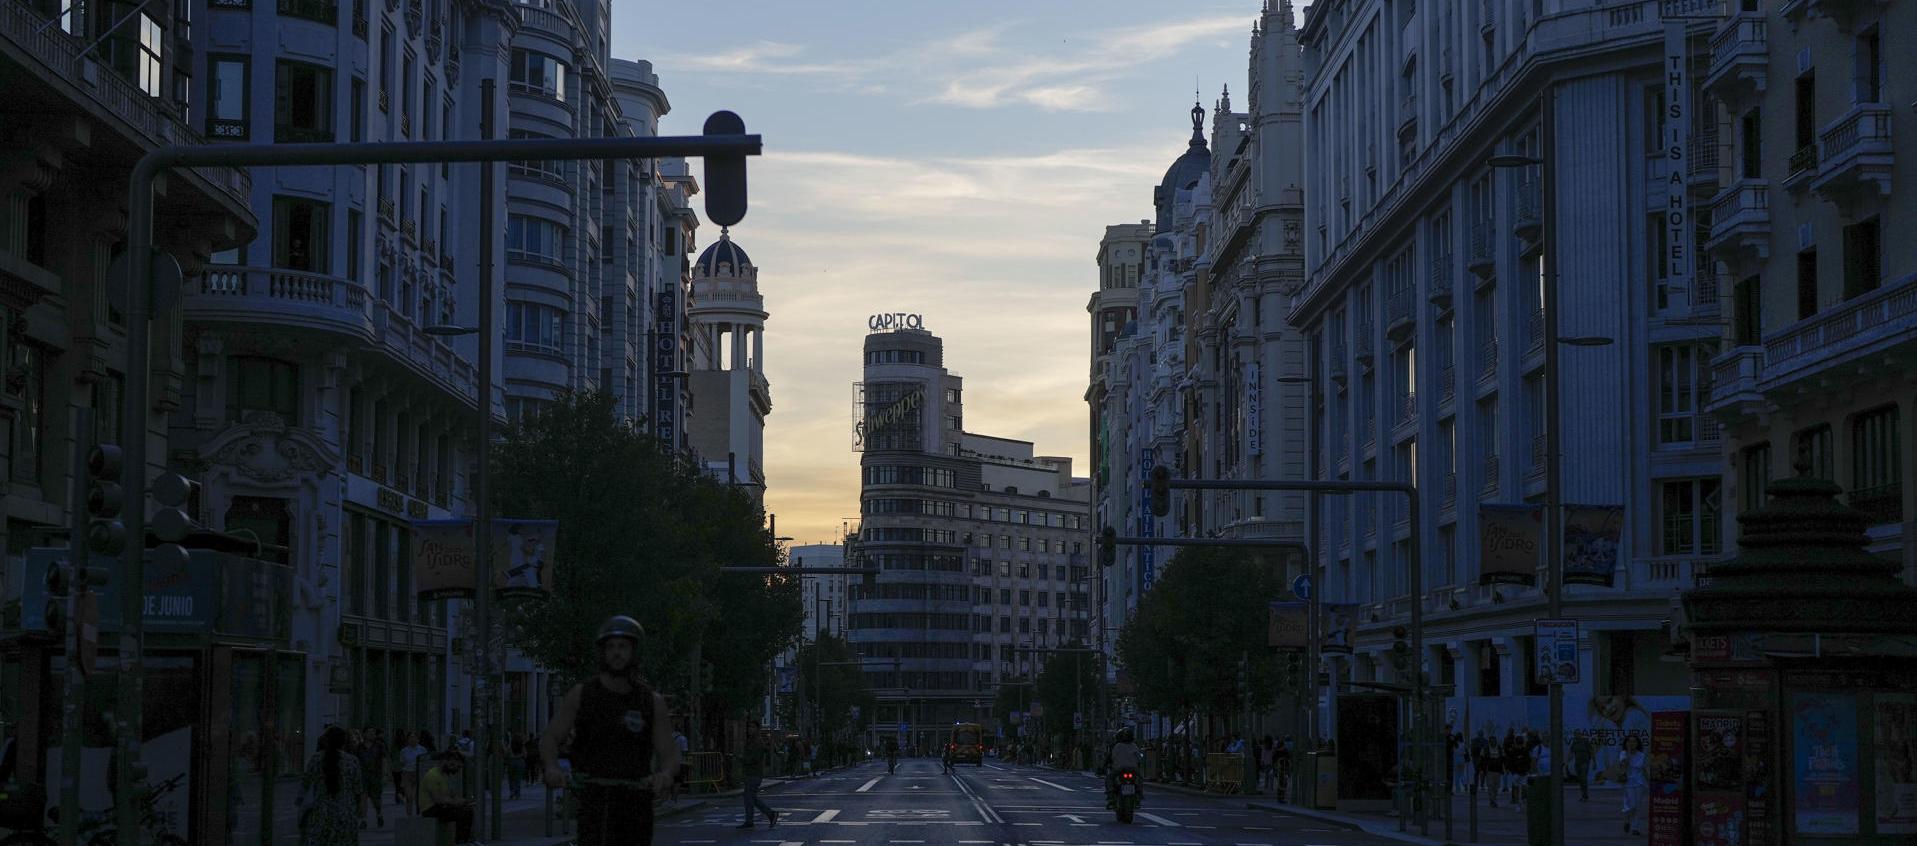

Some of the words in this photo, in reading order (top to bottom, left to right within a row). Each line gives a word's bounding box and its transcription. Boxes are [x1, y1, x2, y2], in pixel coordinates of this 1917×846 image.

[1669, 56, 1681, 118] THIS
[1669, 129, 1681, 160] IS
[1670, 171, 1682, 185] A
[1670, 196, 1682, 276] HOTEL
[869, 312, 925, 330] CAPITOL
[659, 321, 674, 401] HOTEL
[855, 386, 927, 446] Schweppes
[1143, 449, 1152, 498] HOTL
[158, 595, 193, 616] JUNIO
